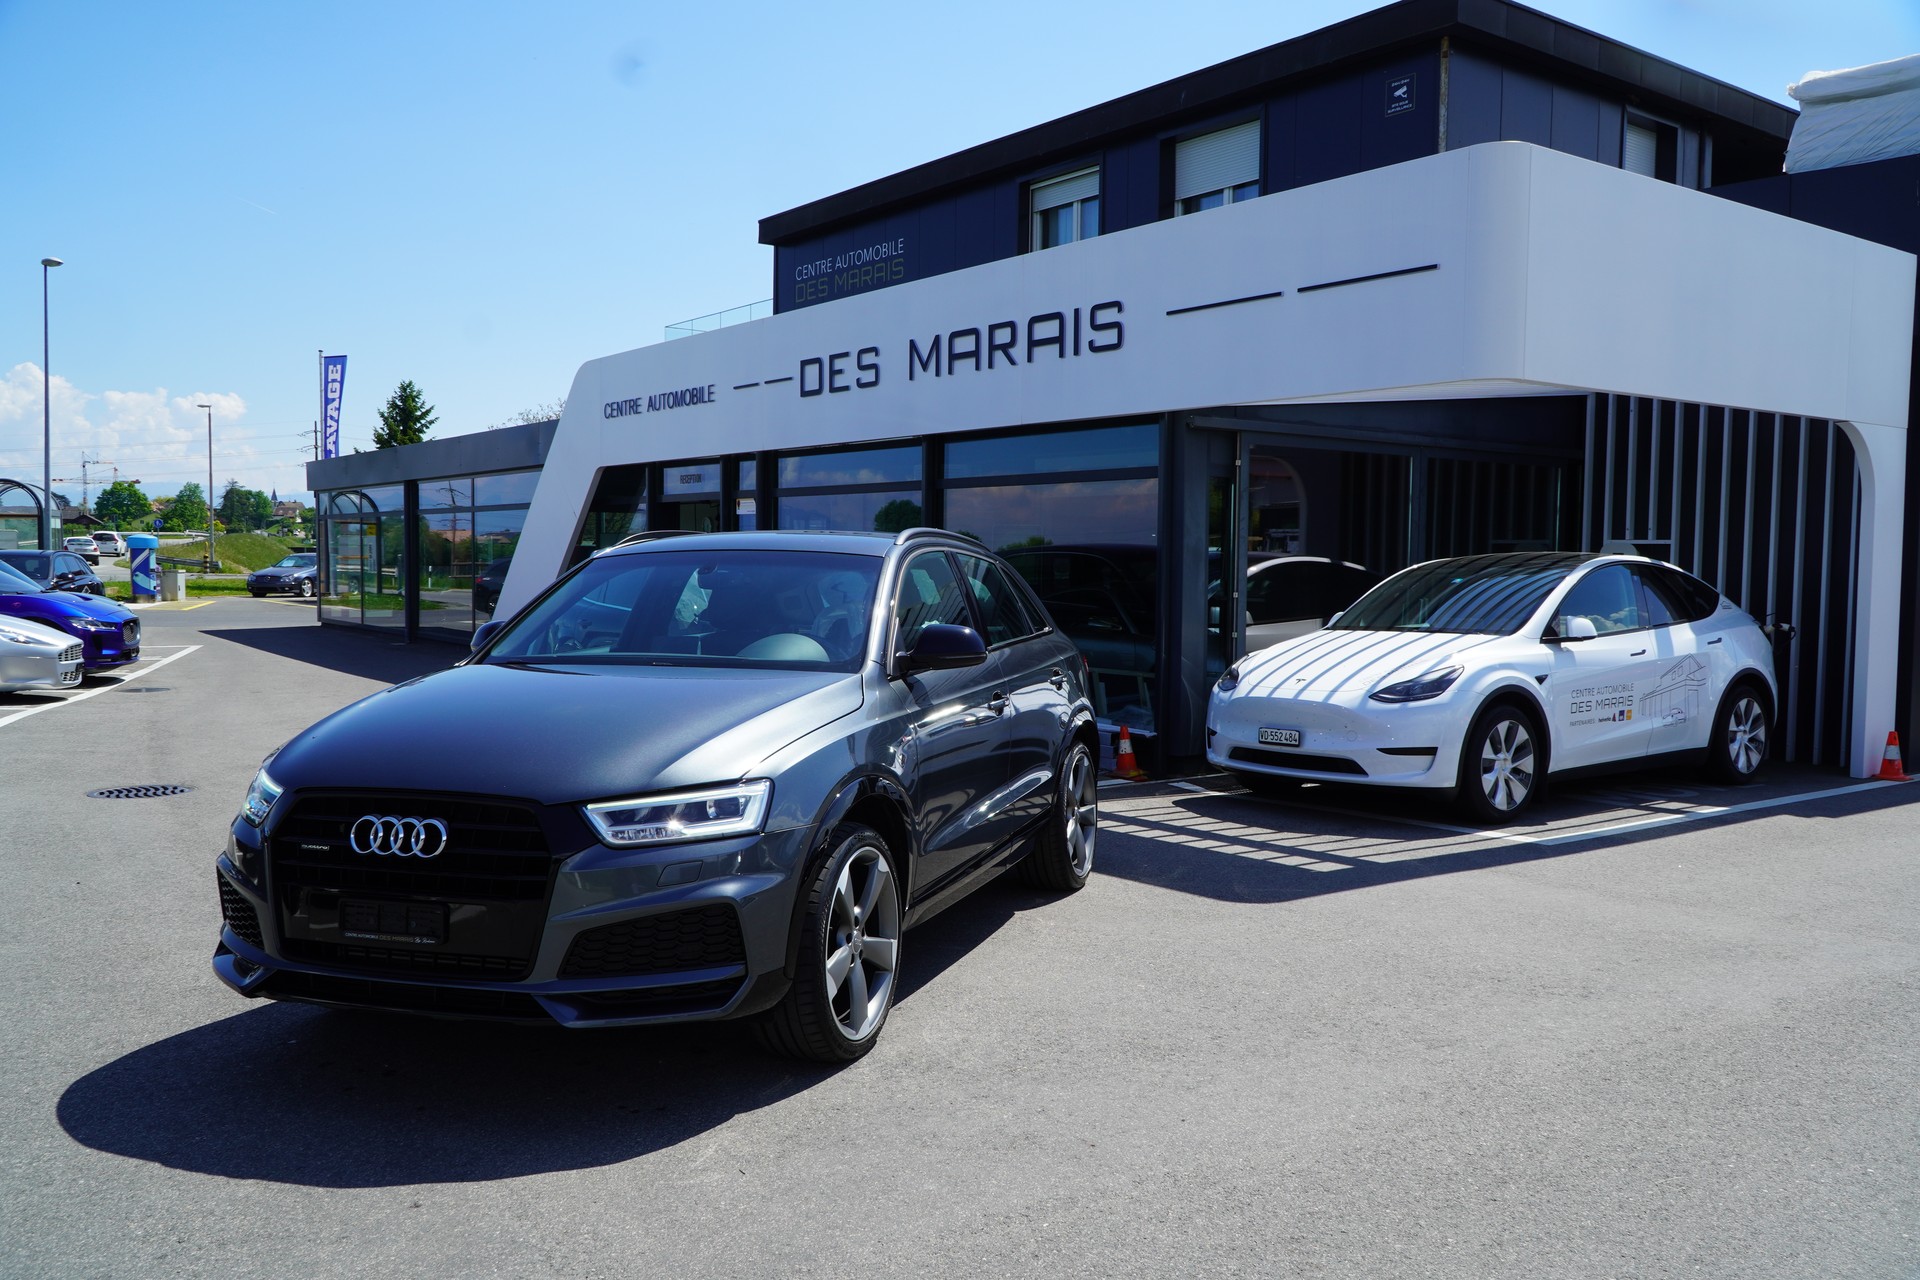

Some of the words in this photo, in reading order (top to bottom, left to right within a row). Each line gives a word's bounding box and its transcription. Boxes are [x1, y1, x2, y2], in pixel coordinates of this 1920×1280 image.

[795, 257, 833, 281] CENTRE
[834, 238, 904, 270] AUTOMOBILE
[795, 277, 828, 303] DES
[834, 258, 904, 293] MARAIS
[603, 397, 643, 419] CENTRE
[646, 384, 716, 412] AUTOMOBILE
[799, 346, 880, 398] DES
[908, 300, 1124, 381] MARAIS
[326, 364, 342, 458] AVAGE
[1570, 700, 1593, 714] DES
[1595, 695, 1634, 710] MARAIS
[1571, 687, 1595, 699] CENTRE
[1596, 683, 1635, 696] AUTOMOBILE
